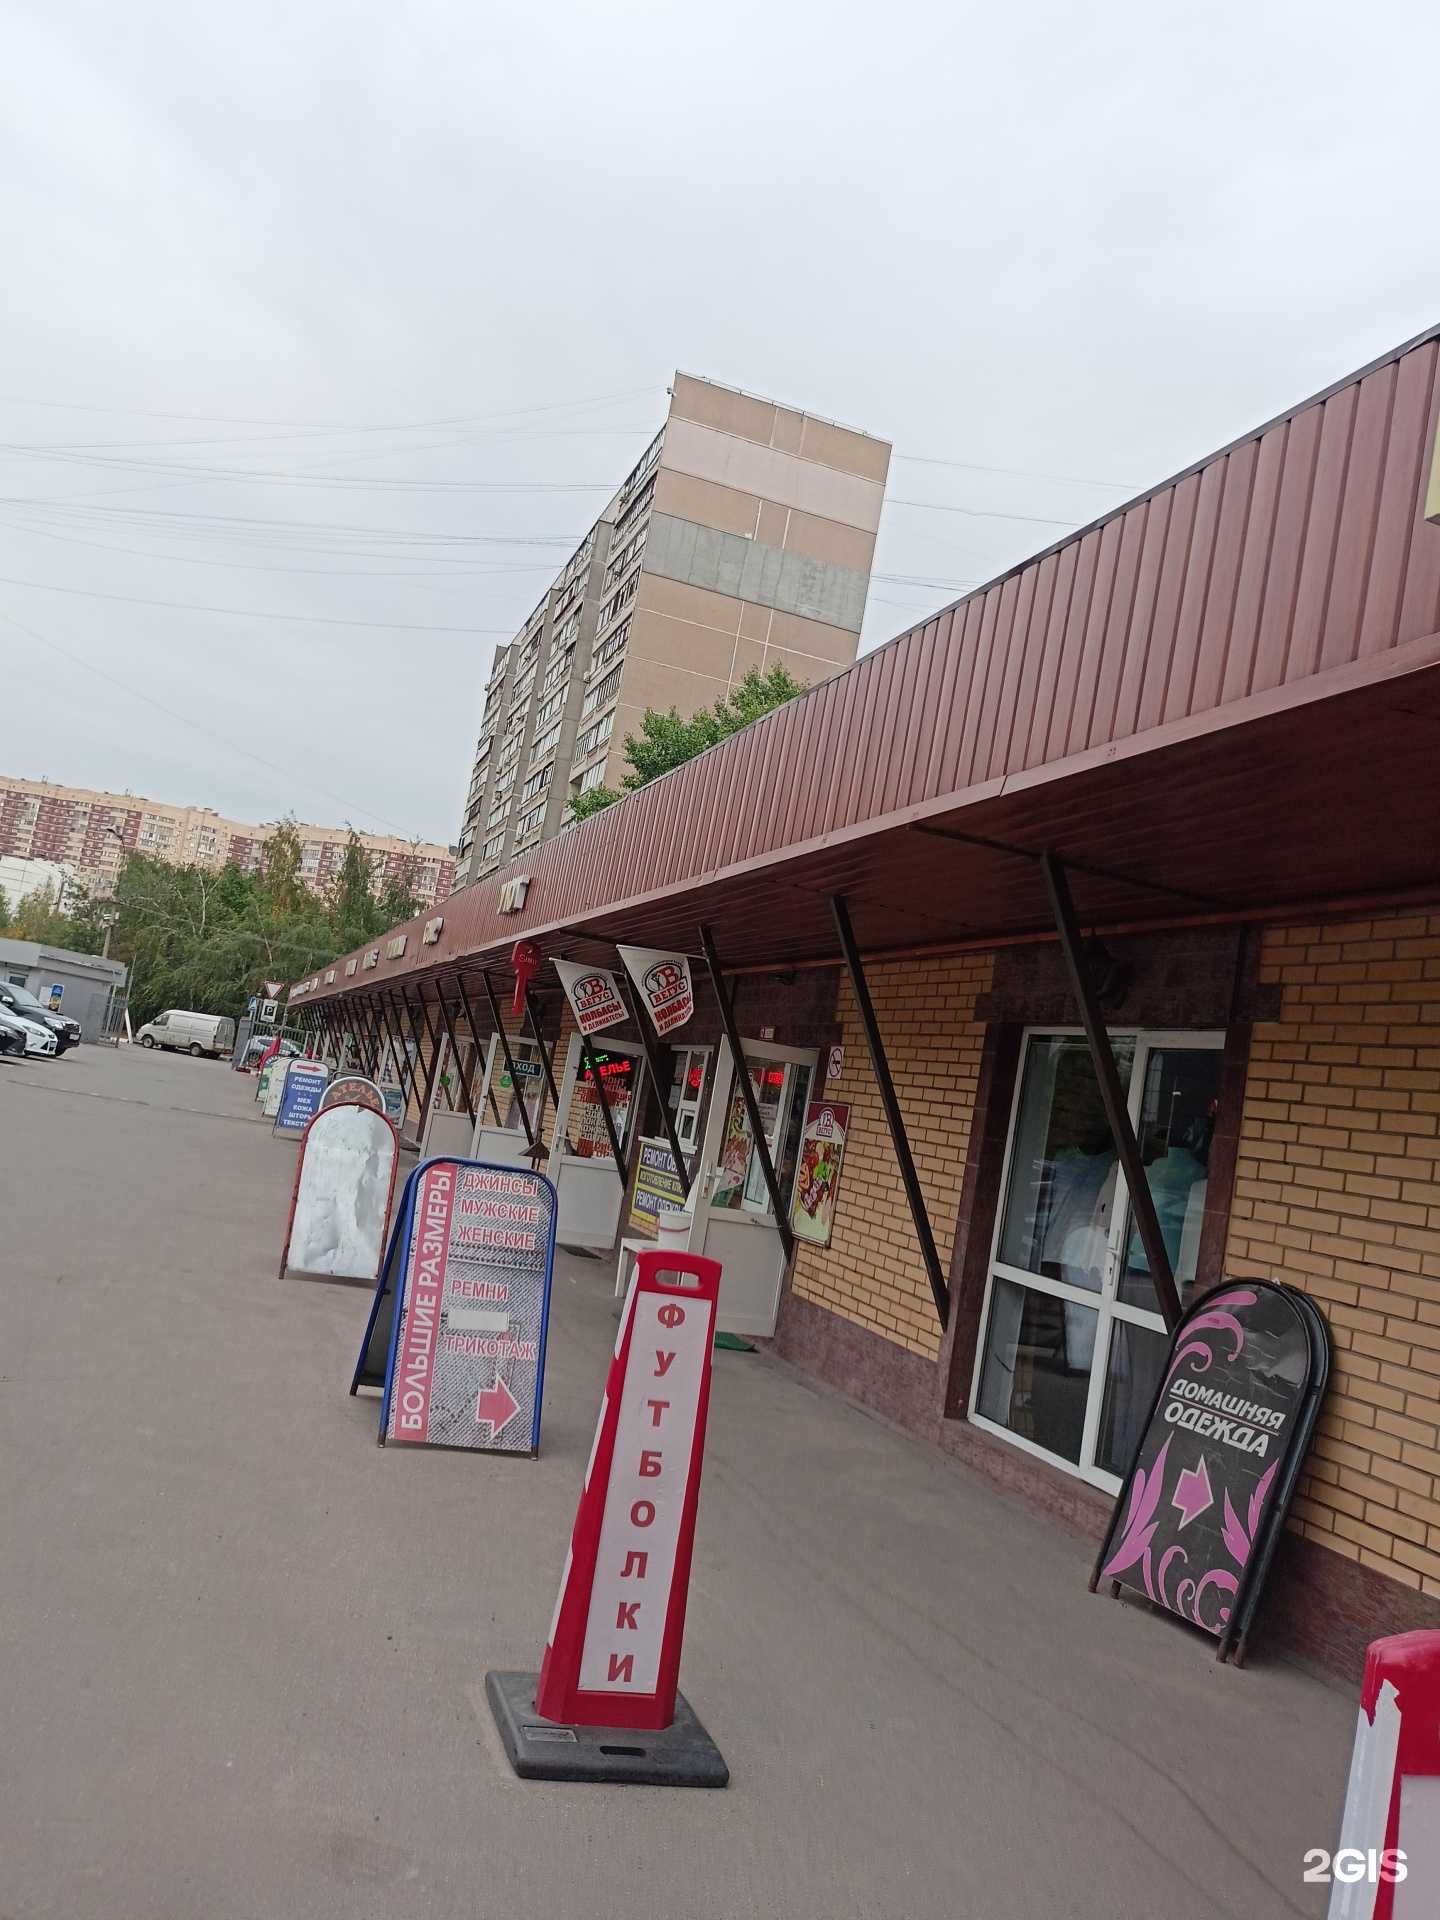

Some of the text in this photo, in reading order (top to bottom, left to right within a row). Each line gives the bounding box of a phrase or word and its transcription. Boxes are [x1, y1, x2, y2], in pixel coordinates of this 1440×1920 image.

[580, 991, 610, 1008] ВЕГУС
[654, 981, 686, 1004] ВЕГУС
[579, 1001, 622, 1025] КОЛБАСЫ
[587, 1011, 625, 1031] ДЕЛИКАТЕСЫ
[294, 1076, 322, 1085] РЕМОНТ
[584, 1060, 632, 1080] АЕЛЬЕ
[291, 1084, 322, 1093] ОДЕЖДЫ
[643, 1147, 667, 1168] РЕМОНТ
[463, 1171, 538, 1196] ДЖИНСЫ
[461, 1199, 539, 1222] МУЖСКИЕ
[636, 1190, 658, 1213] РЕМОНТ
[457, 1225, 536, 1249] ЖЕНСКИЕ
[401, 1170, 452, 1430] БОЛЬШИЕ РАЗМЕРЫ
[451, 1280, 509, 1301] РЕМНИ
[445, 1335, 536, 1361] ТРИКОТАЖ
[1170, 1378, 1287, 1430] ДОМАШНЯЯ
[1164, 1401, 1270, 1458] ОДЕЖДА
[606, 1303, 686, 1683] ФУТБОЛКИ
